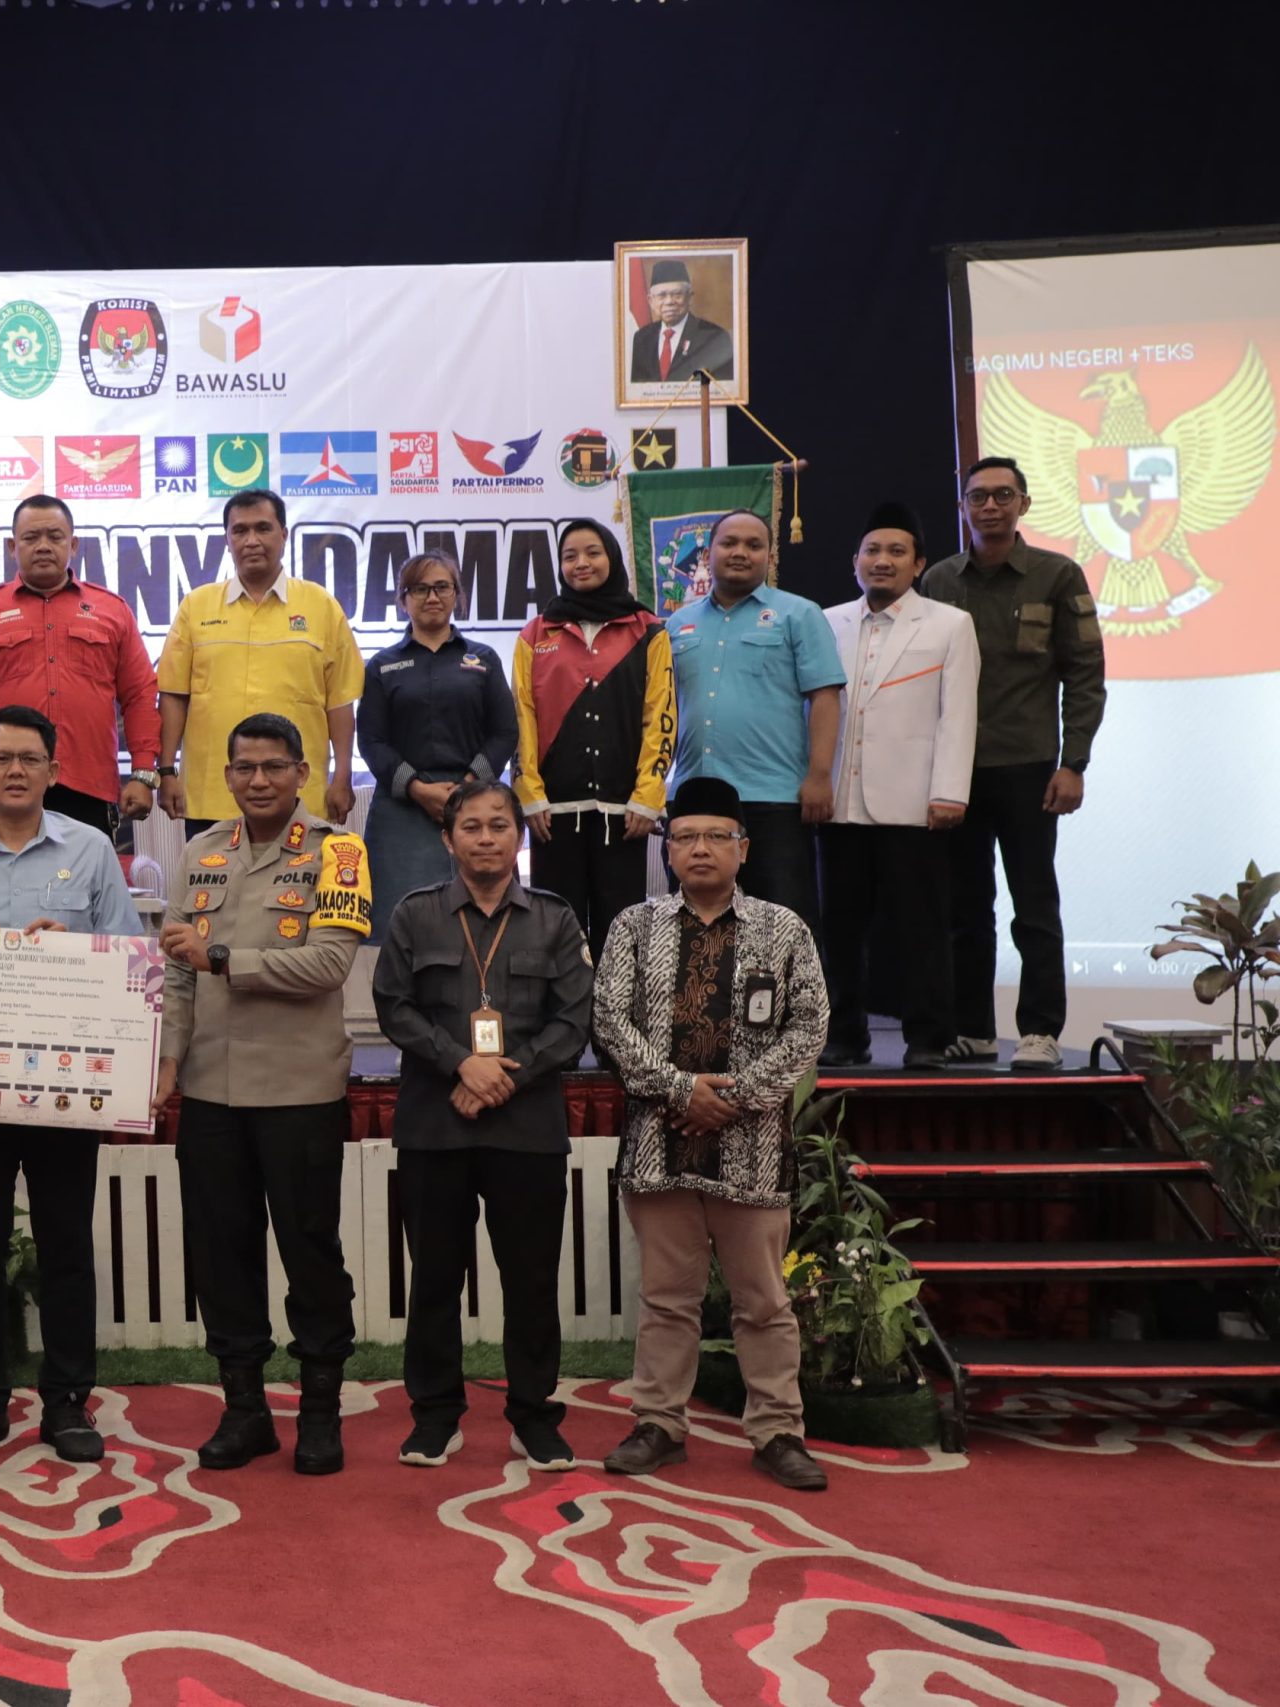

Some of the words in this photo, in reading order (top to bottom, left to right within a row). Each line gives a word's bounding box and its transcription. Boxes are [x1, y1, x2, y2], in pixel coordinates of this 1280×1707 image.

[97, 299, 148, 311] KOMISI
[1050, 348, 1123, 368] NEGERI
[81, 355, 143, 398] PEMILIHAN
[145, 353, 166, 395] UMUM
[176, 372, 287, 392] BAWASLU
[391, 439, 414, 453] PSI
[63, 484, 93, 493] PARTAI
[94, 484, 133, 492] GARUDA
[155, 478, 197, 493] PAN
[452, 477, 494, 487] PARTAI
[495, 477, 544, 486] PERINDO
[286, 488, 319, 496] PARTAI
[320, 487, 373, 495] DEMOKRAT
[390, 486, 439, 494] INDONESIA
[302, 529, 560, 622] DAMA
[189, 873, 228, 886] DARNO
[273, 872, 318, 887] POLRI
[1148, 959, 1178, 975] 0:00
